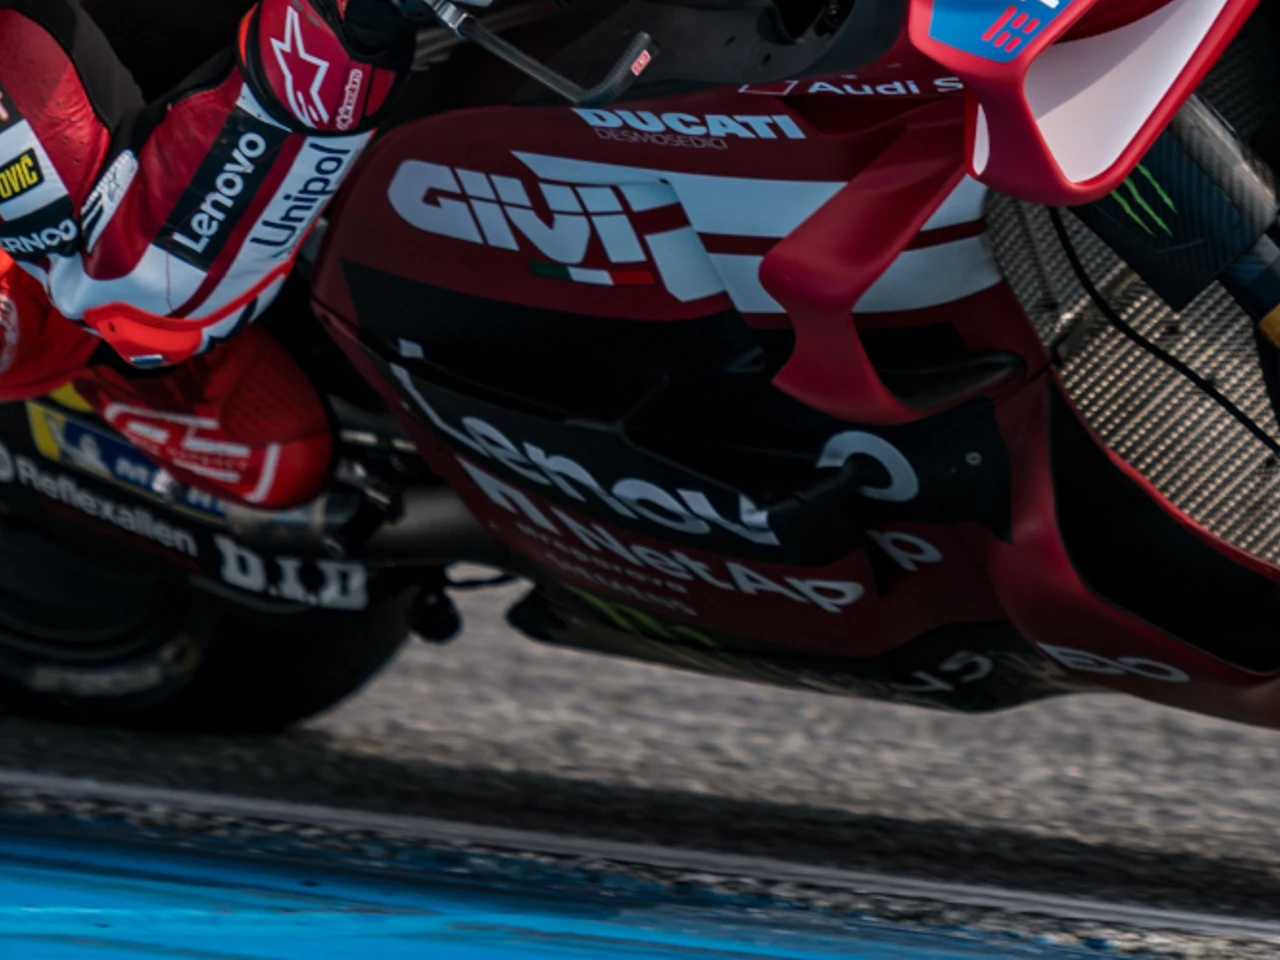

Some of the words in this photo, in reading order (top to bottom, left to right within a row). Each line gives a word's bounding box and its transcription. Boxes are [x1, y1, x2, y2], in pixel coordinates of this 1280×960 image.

[571, 107, 807, 140] DUCATI
[805, 77, 921, 96] Audi
[594, 127, 728, 150] DESMOSEDICI
[173, 132, 266, 253] Lenovo
[250, 143, 350, 247] Unipol
[386, 156, 648, 266] GIVI
[15, 456, 200, 558] Reflexallen
